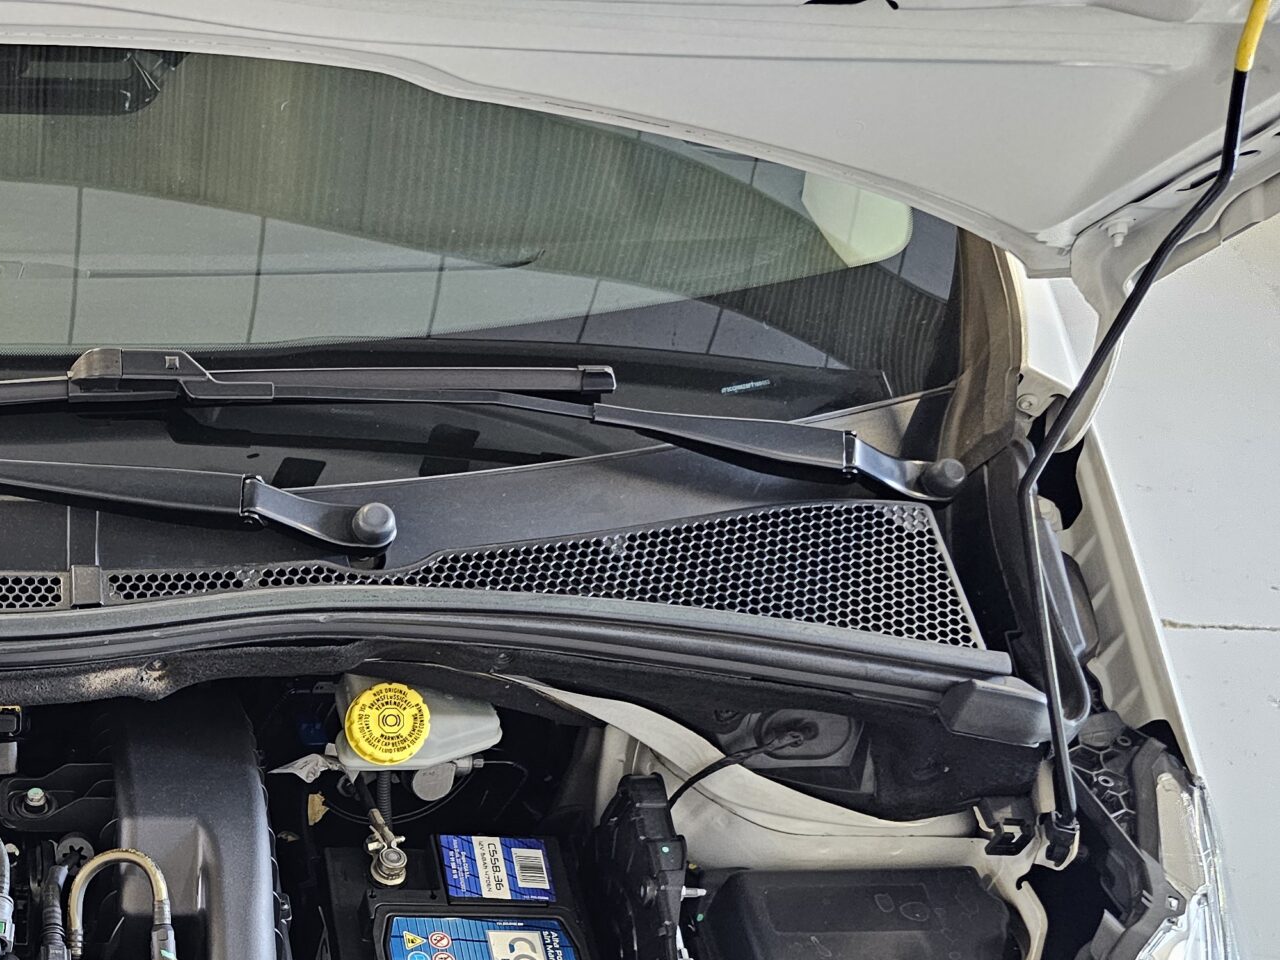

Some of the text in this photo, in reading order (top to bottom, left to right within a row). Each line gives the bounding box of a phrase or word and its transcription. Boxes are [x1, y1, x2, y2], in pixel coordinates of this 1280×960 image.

[385, 688, 408, 697] ORIGINAL
[391, 737, 409, 747] BEFORE
[543, 930, 552, 943] sin
[551, 931, 561, 948] Alta
